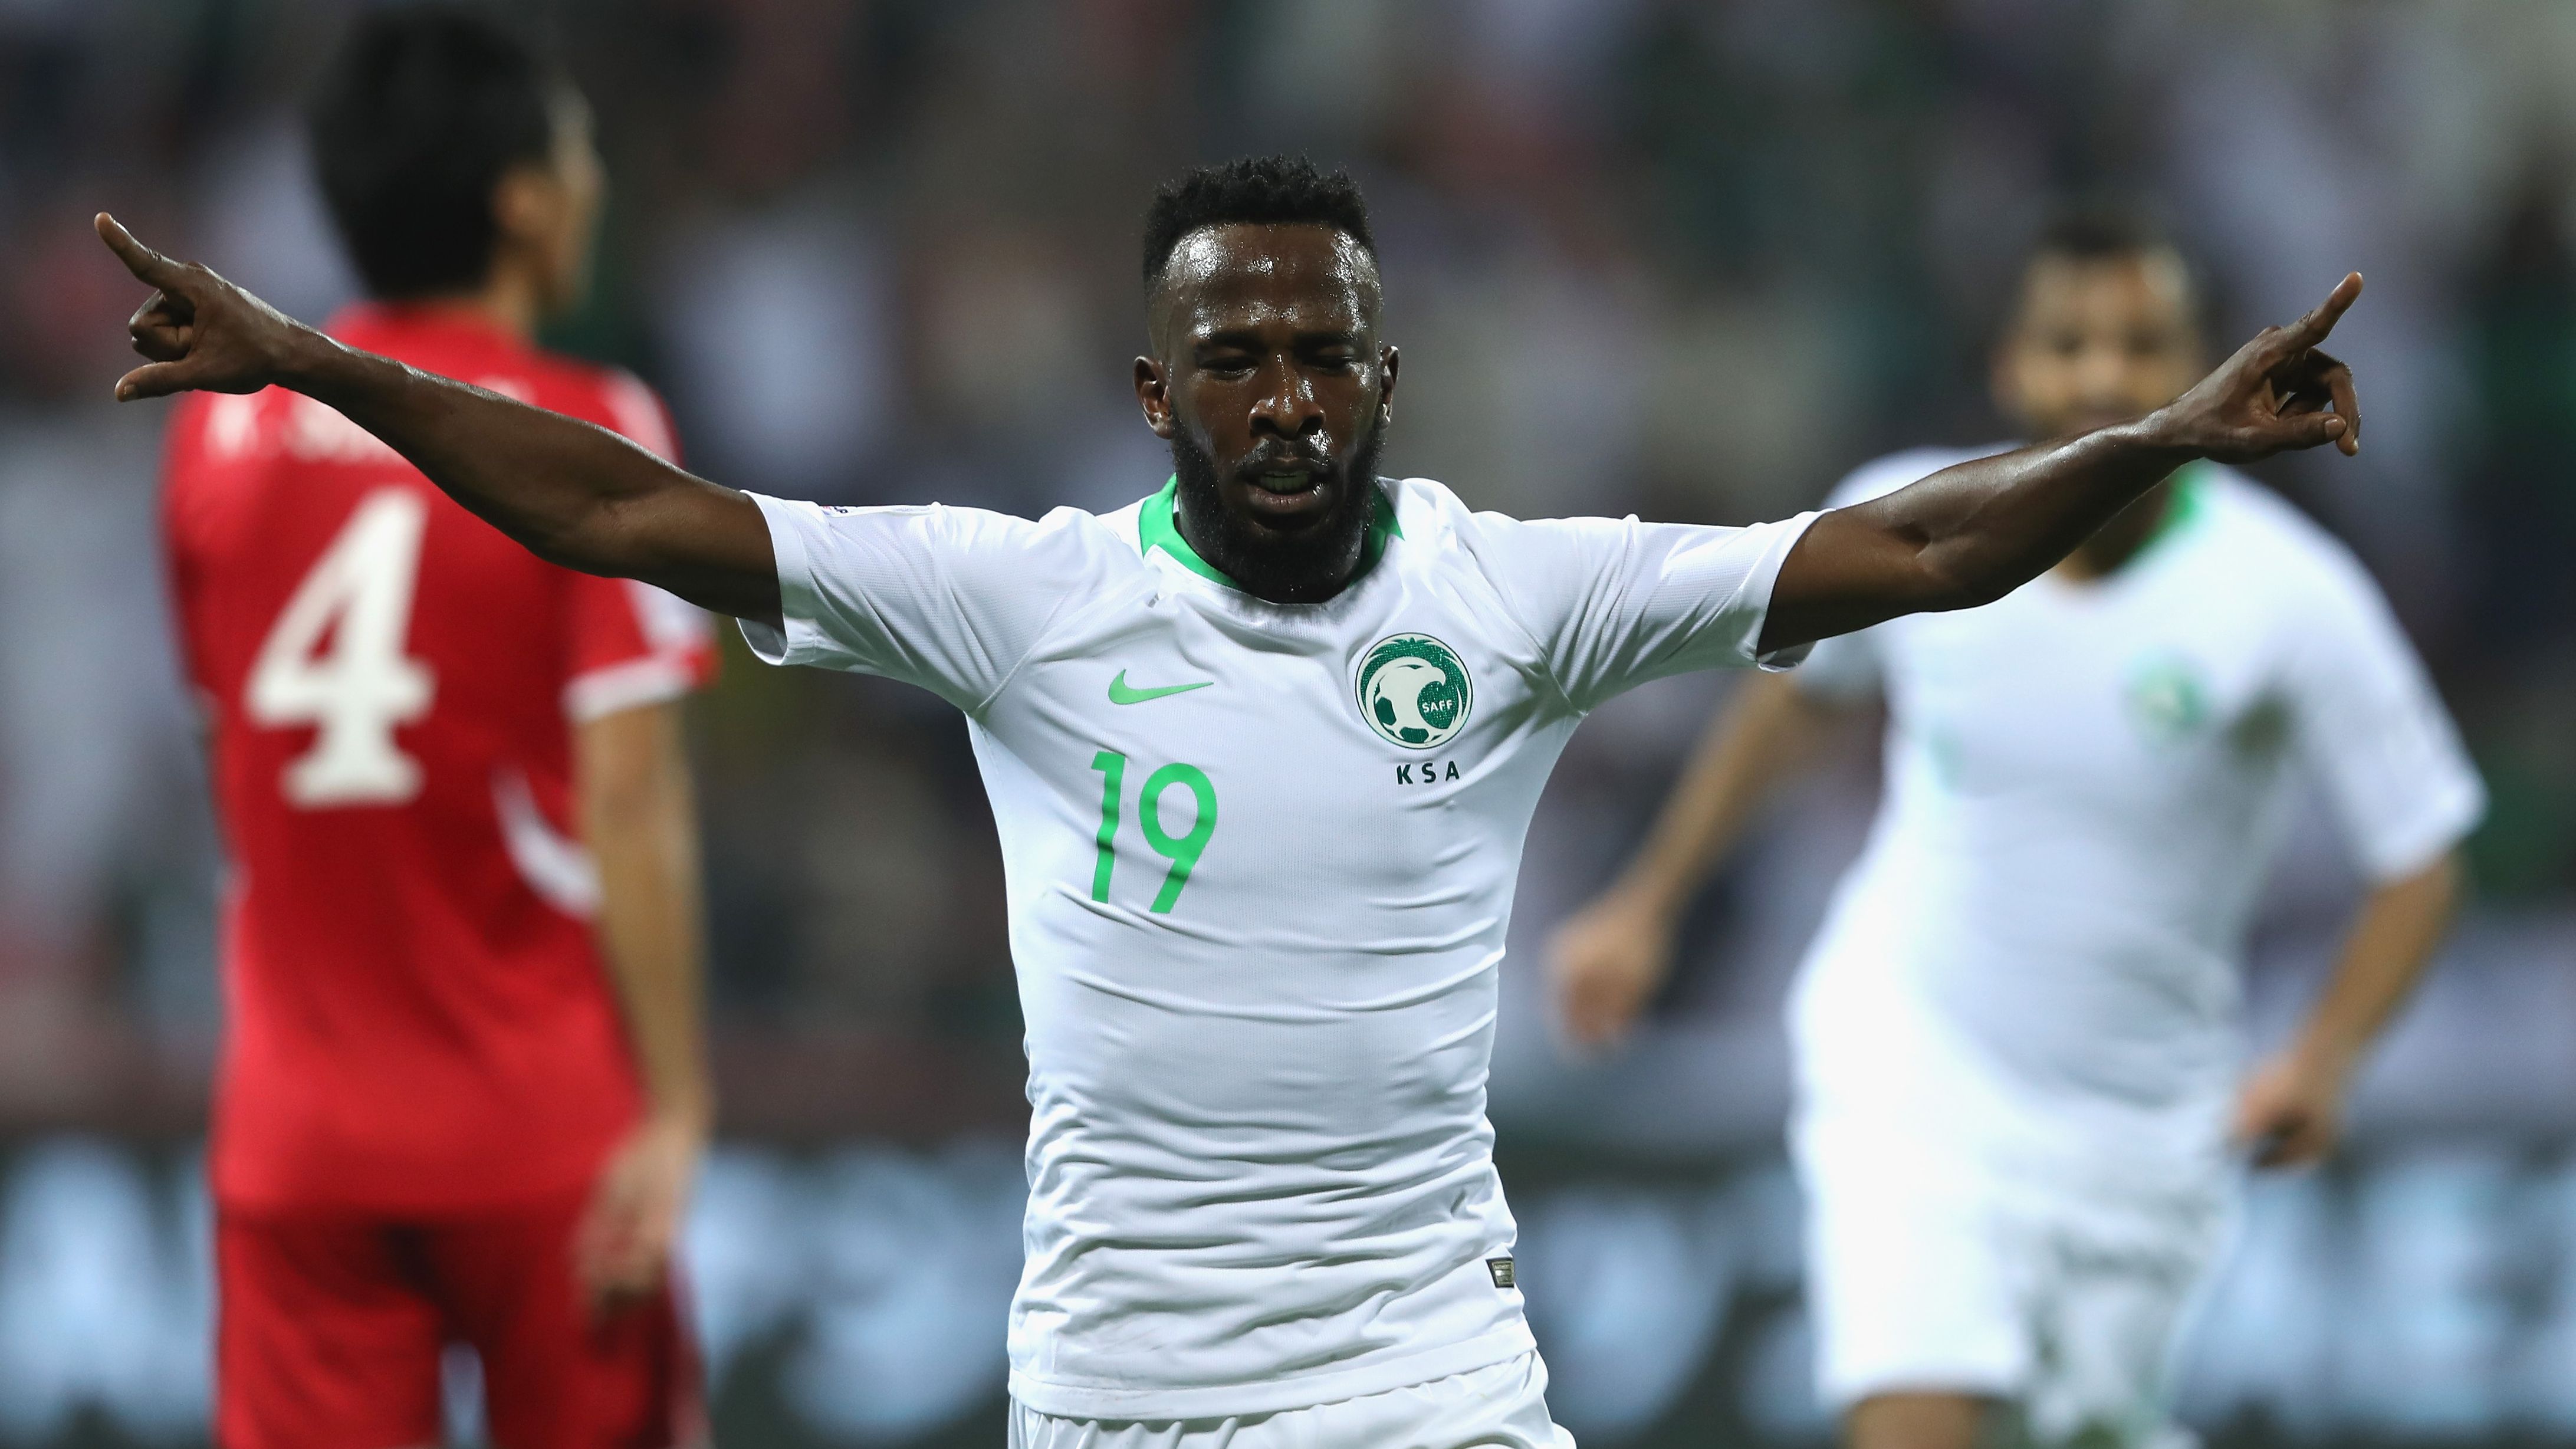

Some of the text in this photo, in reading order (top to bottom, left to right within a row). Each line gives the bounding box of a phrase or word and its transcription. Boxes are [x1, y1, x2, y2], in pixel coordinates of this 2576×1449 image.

[245, 491, 435, 807] 4
[1422, 699, 1453, 713] SAFF
[1396, 761, 1460, 784] KSA
[1091, 751, 1217, 914] 19
